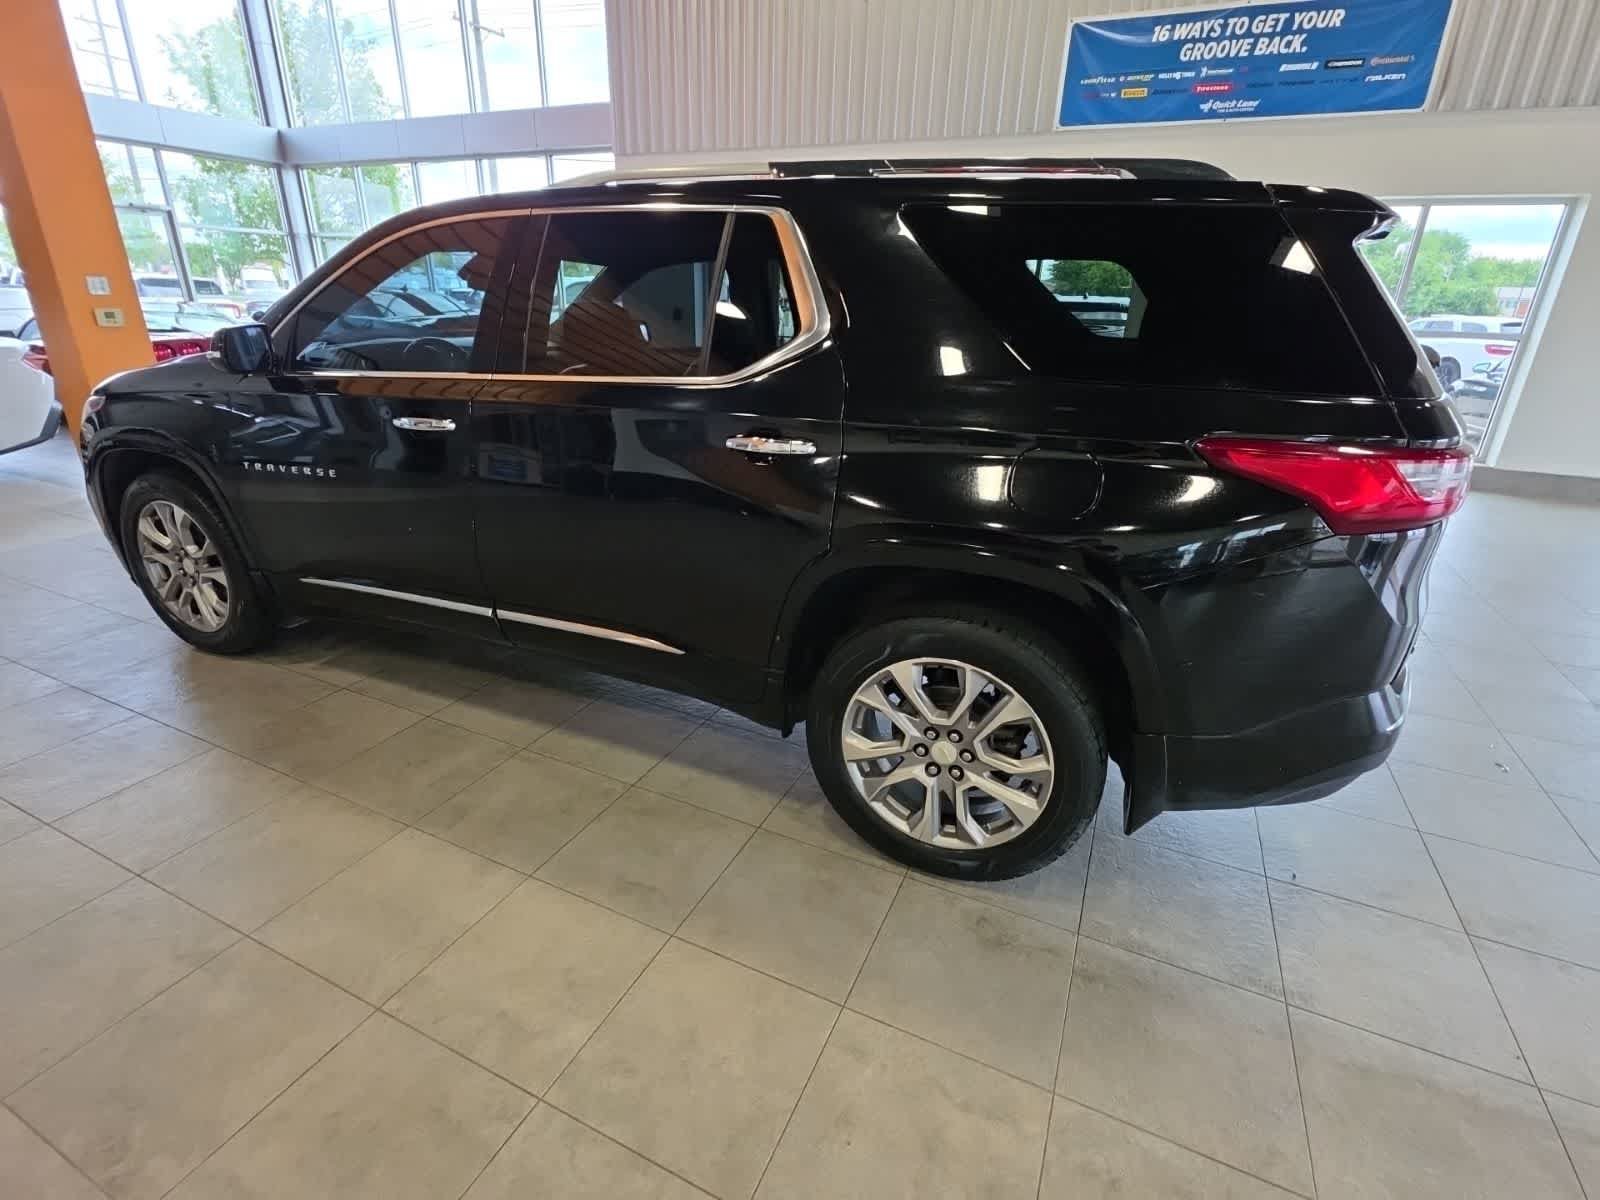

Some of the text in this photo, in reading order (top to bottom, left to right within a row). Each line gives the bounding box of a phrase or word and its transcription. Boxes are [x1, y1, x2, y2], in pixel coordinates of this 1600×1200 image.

[1152, 8, 1346, 43] 16 WAYS TO GET YOUR
[1179, 33, 1308, 62] GROOVE BACK.
[1364, 73, 1407, 82] FALKEN
[1212, 99, 1261, 110] Quick Lane
[242, 461, 337, 478] TRAVERSE
